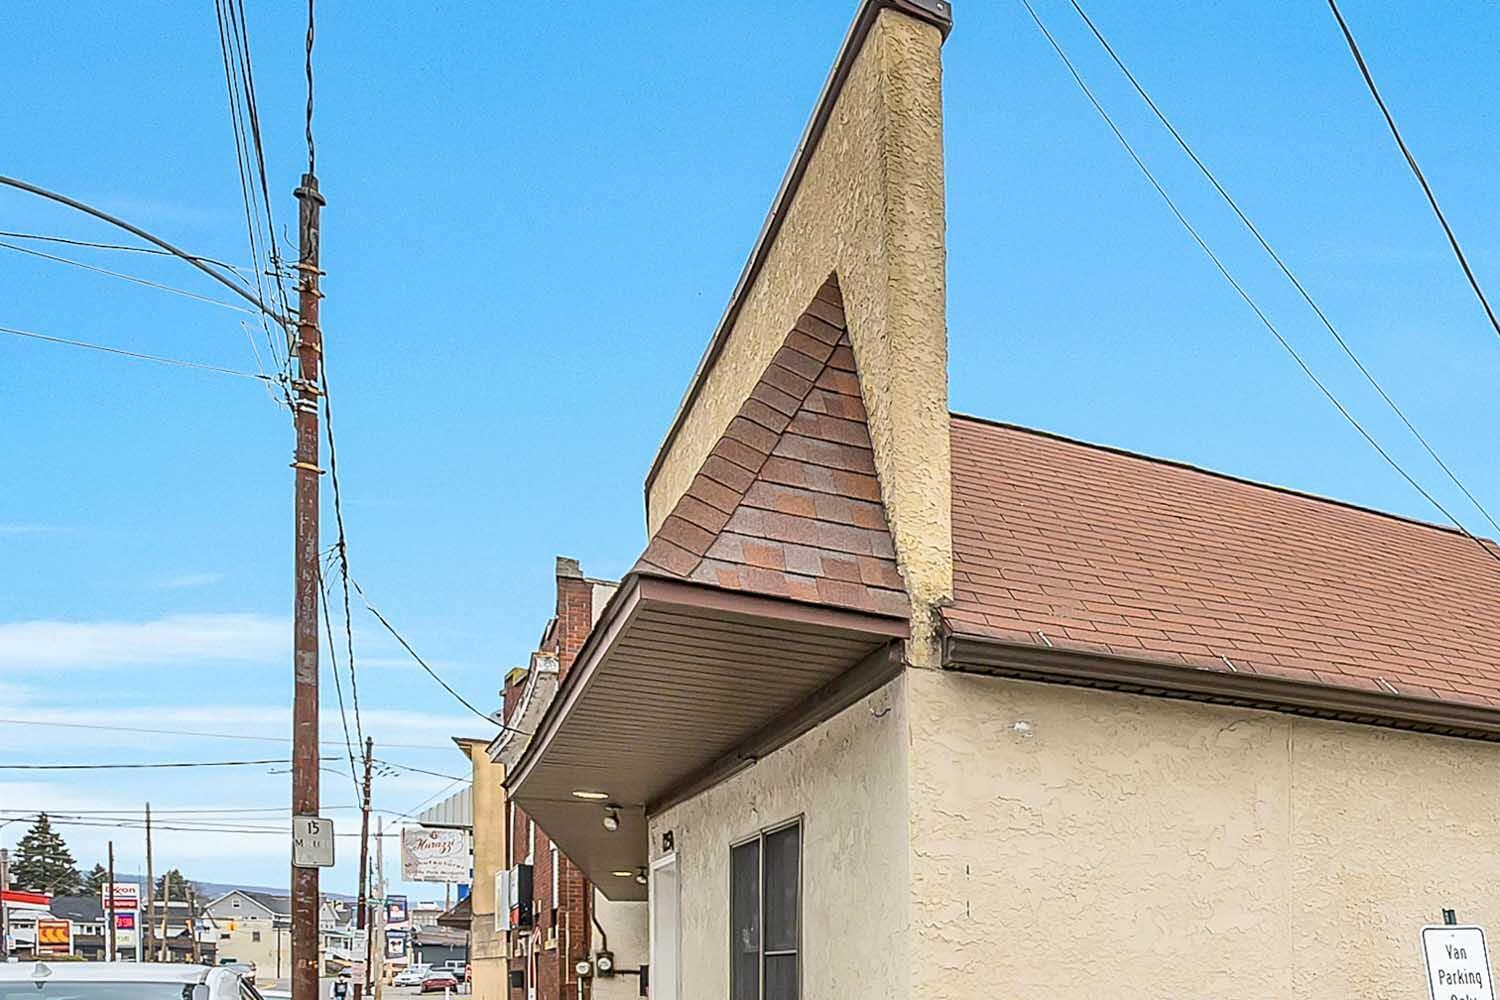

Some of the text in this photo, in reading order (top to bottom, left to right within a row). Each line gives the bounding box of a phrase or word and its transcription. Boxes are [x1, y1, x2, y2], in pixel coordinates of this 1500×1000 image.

[307, 820, 320, 835] 15
[1445, 944, 1467, 960] Van
[1438, 968, 1483, 989] Parking
